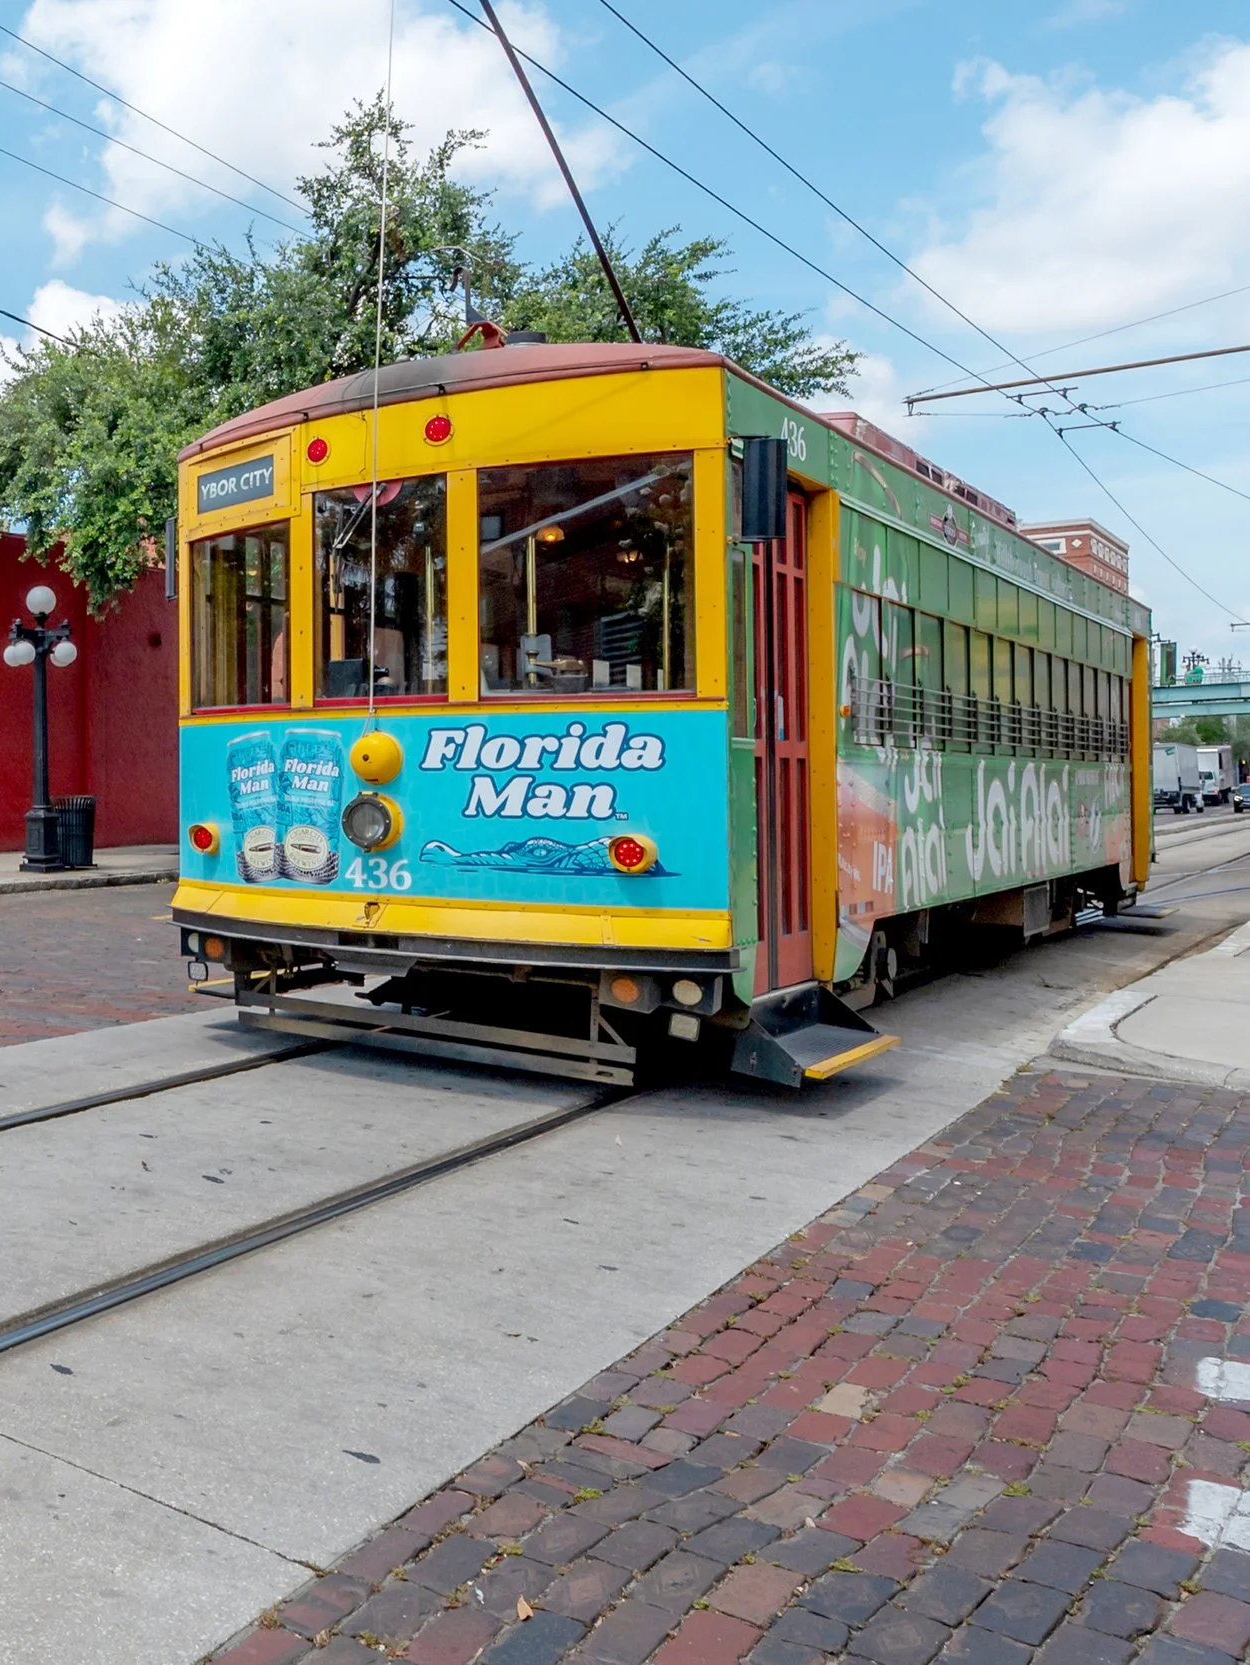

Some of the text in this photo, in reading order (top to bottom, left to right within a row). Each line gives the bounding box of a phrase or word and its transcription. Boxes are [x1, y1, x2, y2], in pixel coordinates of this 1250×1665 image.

[781, 416, 806, 461] 436
[201, 466, 273, 500] YBOR CITY
[419, 721, 666, 772] Florida
[231, 759, 275, 782] Florida
[284, 758, 340, 778] Florida
[291, 775, 330, 793] Man
[239, 779, 269, 796] Man
[462, 774, 617, 821] Man
[344, 856, 412, 891] 436
[872, 840, 894, 894] IPA
